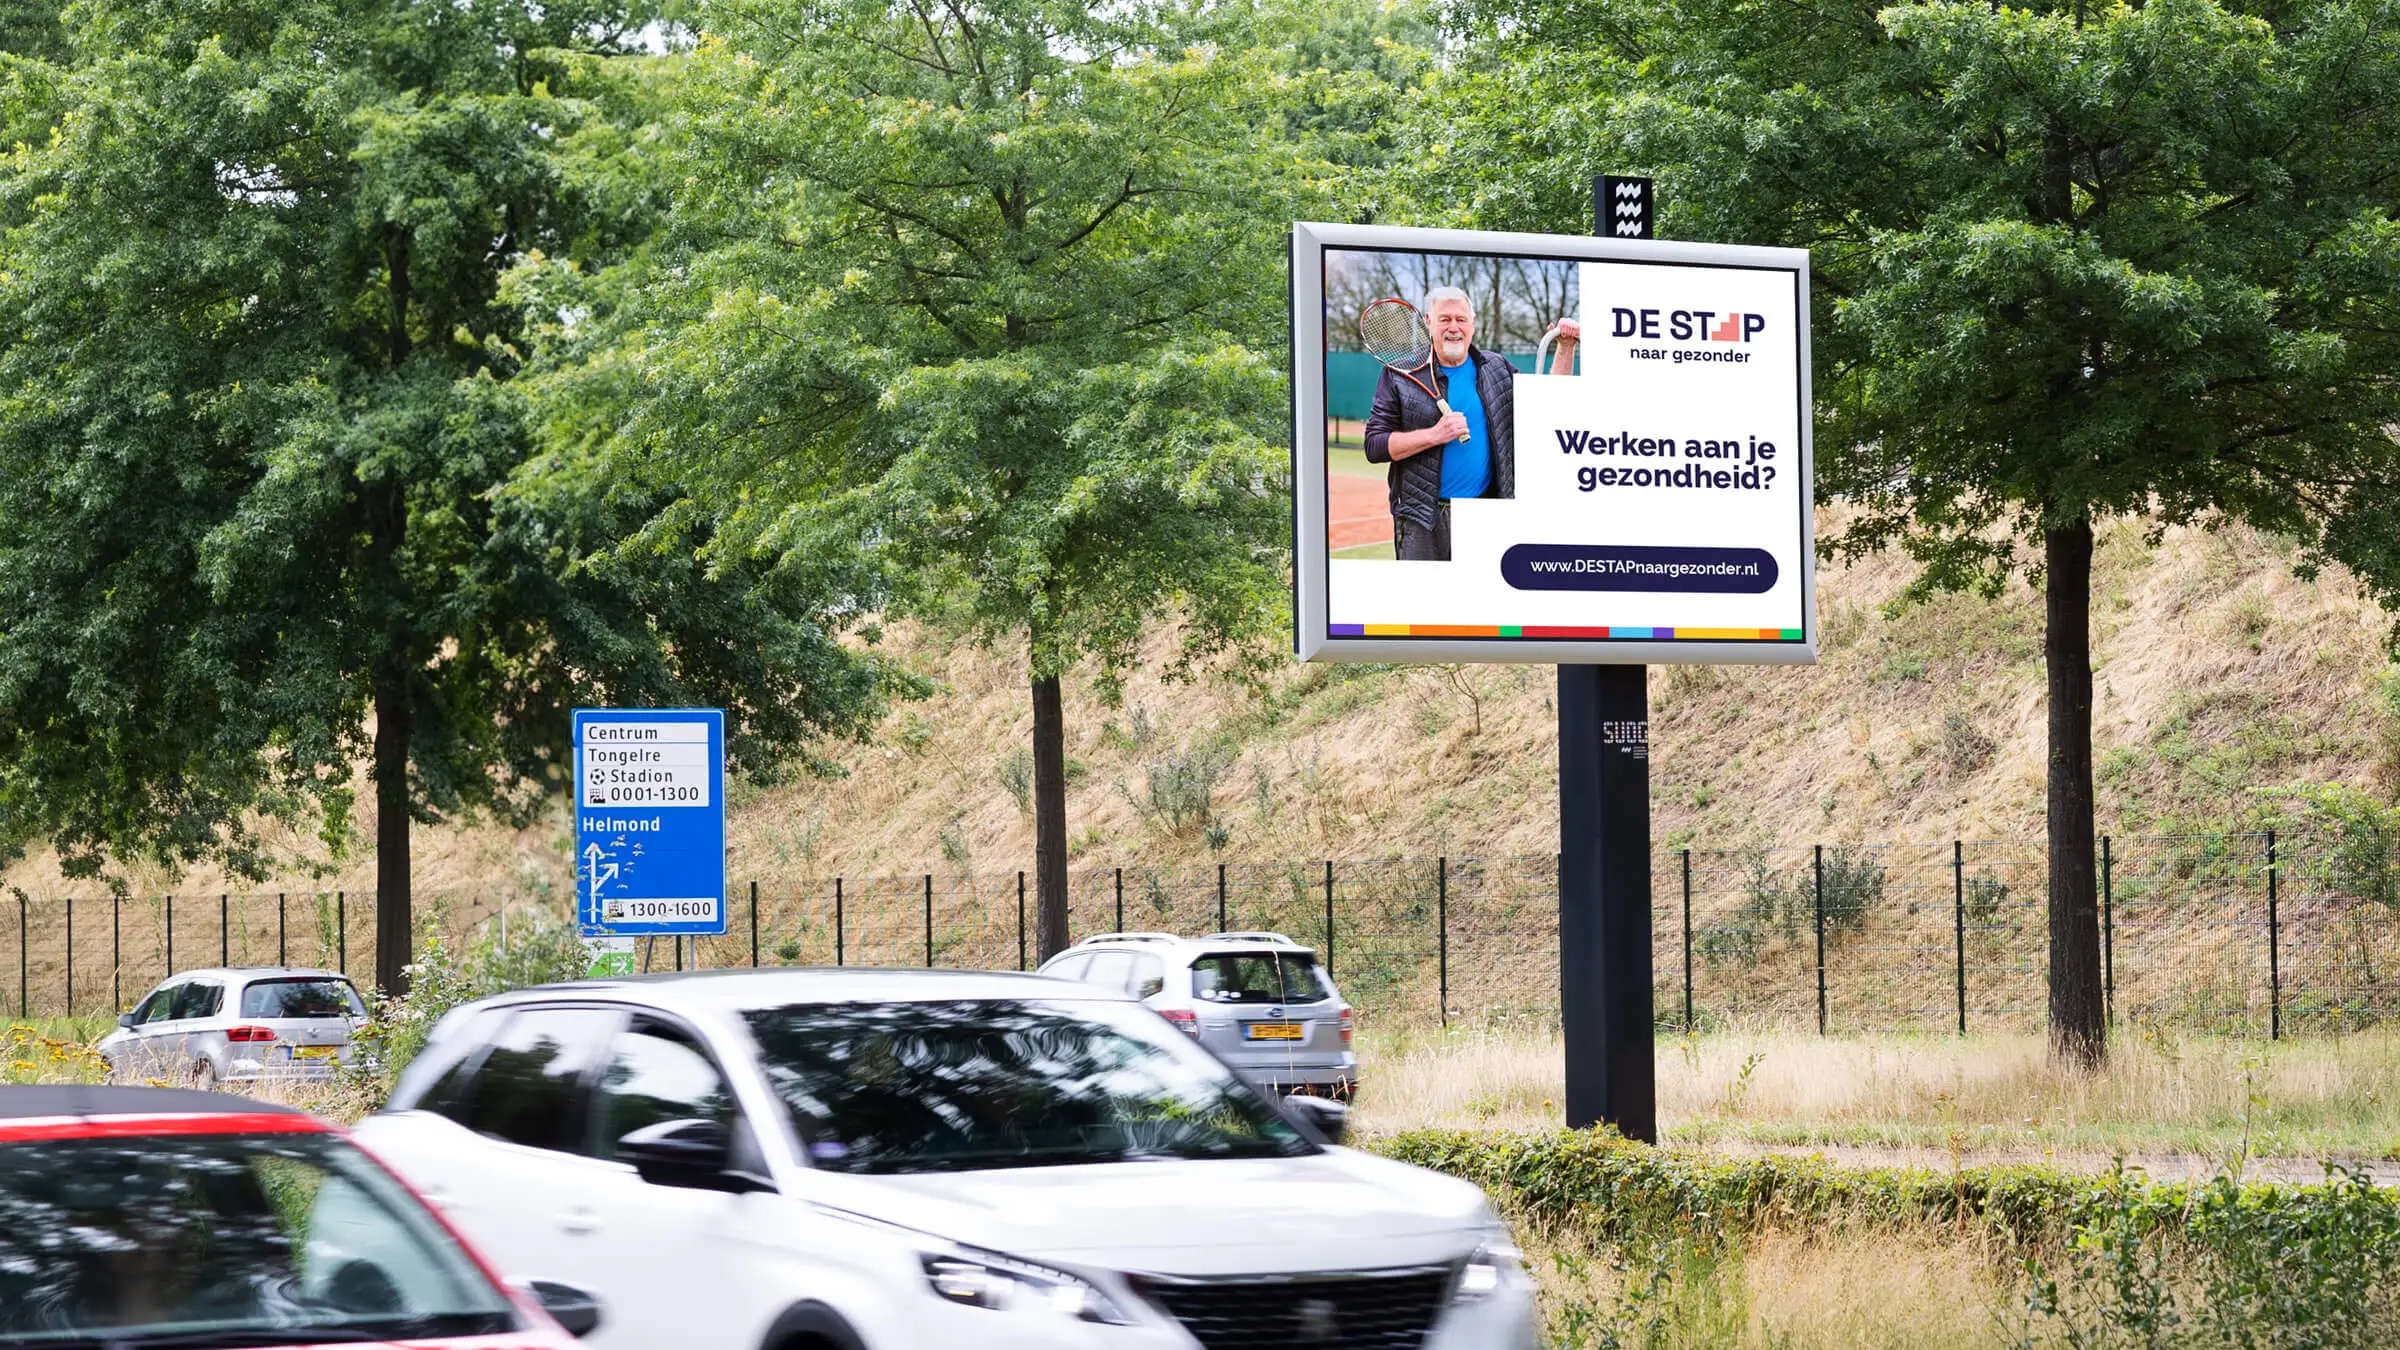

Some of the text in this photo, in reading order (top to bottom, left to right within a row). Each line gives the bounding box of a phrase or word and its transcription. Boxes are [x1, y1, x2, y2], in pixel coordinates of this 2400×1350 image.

[1611, 307, 1661, 339] DE
[1630, 348, 1751, 364] naar gezonder
[1554, 429, 1777, 466] Werken aan je
[1577, 463, 1777, 493] gezondheid?
[1530, 559, 1760, 579] www.DESTAPnaargezonder.nl
[588, 726, 658, 740] Centrum
[588, 748, 661, 766] Tongelre
[610, 768, 673, 783] Stadion
[611, 786, 699, 801] 0001-1300
[583, 816, 660, 832] Helmond
[630, 902, 711, 917] 1300-1600
